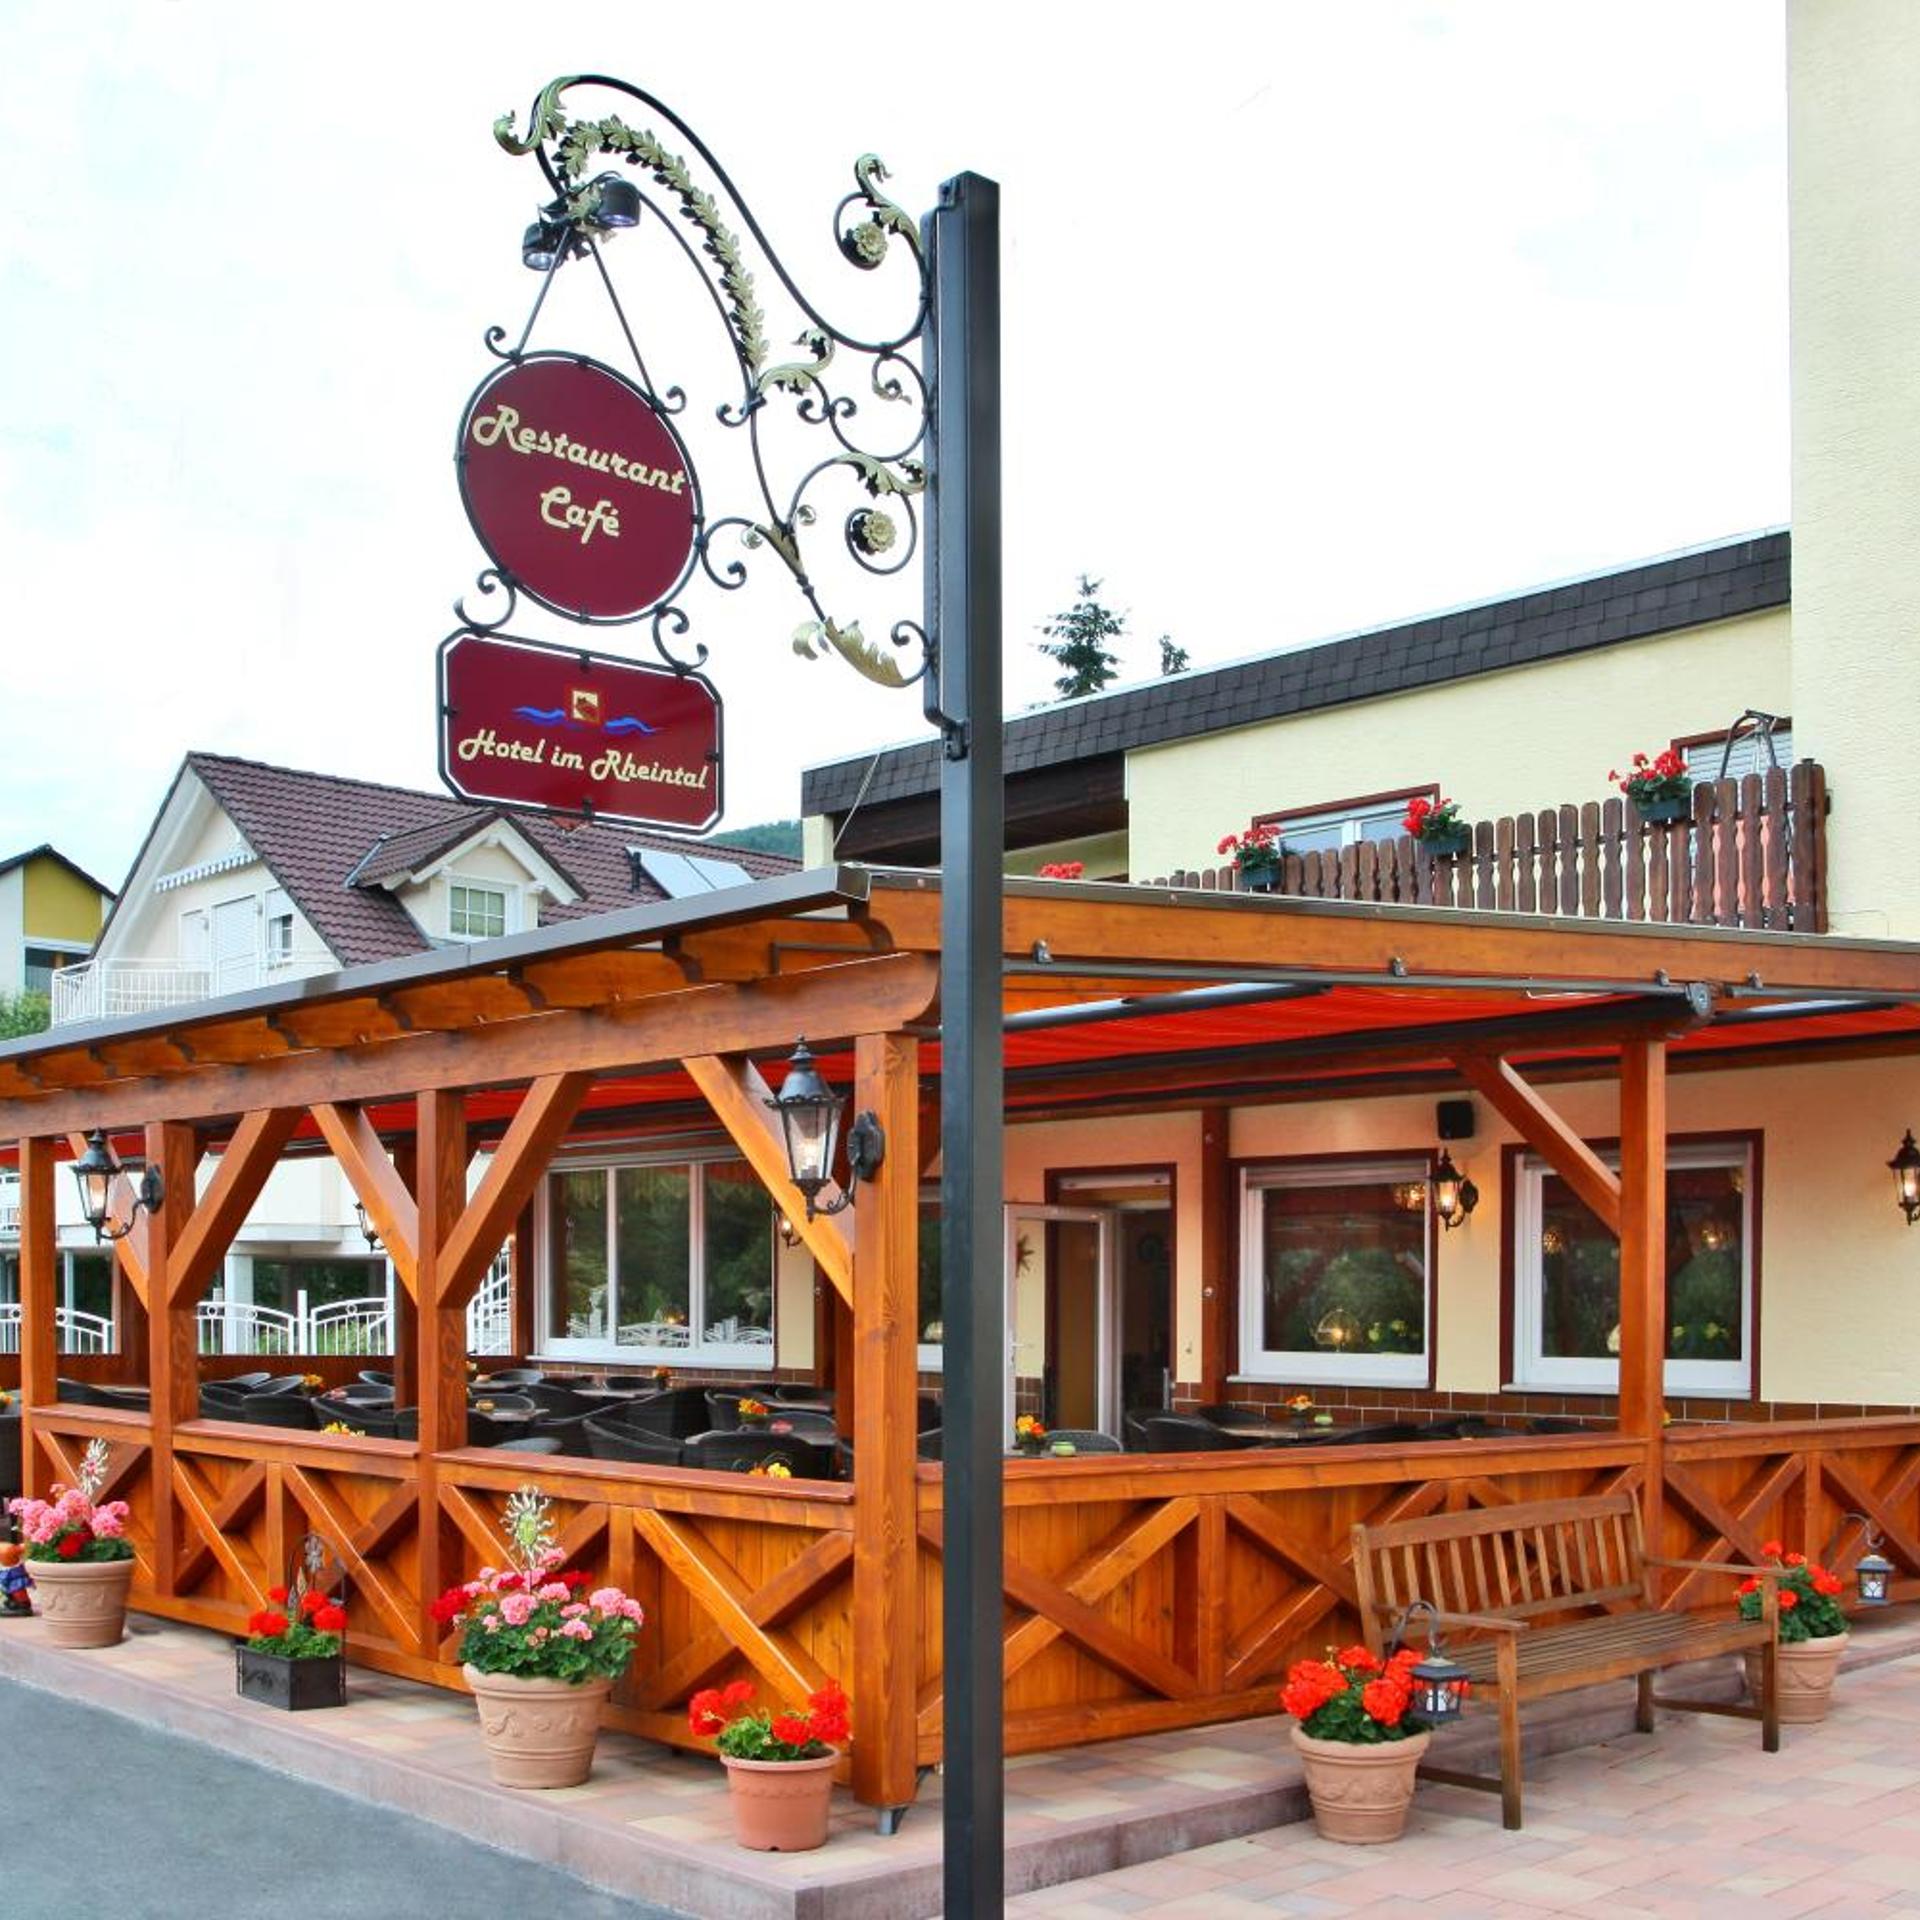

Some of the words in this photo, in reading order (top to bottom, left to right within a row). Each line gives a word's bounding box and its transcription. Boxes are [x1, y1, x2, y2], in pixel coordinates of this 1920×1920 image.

[471, 404, 687, 495] Restaurant
[539, 486, 620, 545] Café
[458, 729, 546, 763] Hotel
[550, 746, 585, 771] im
[590, 749, 709, 789] Rheintal
